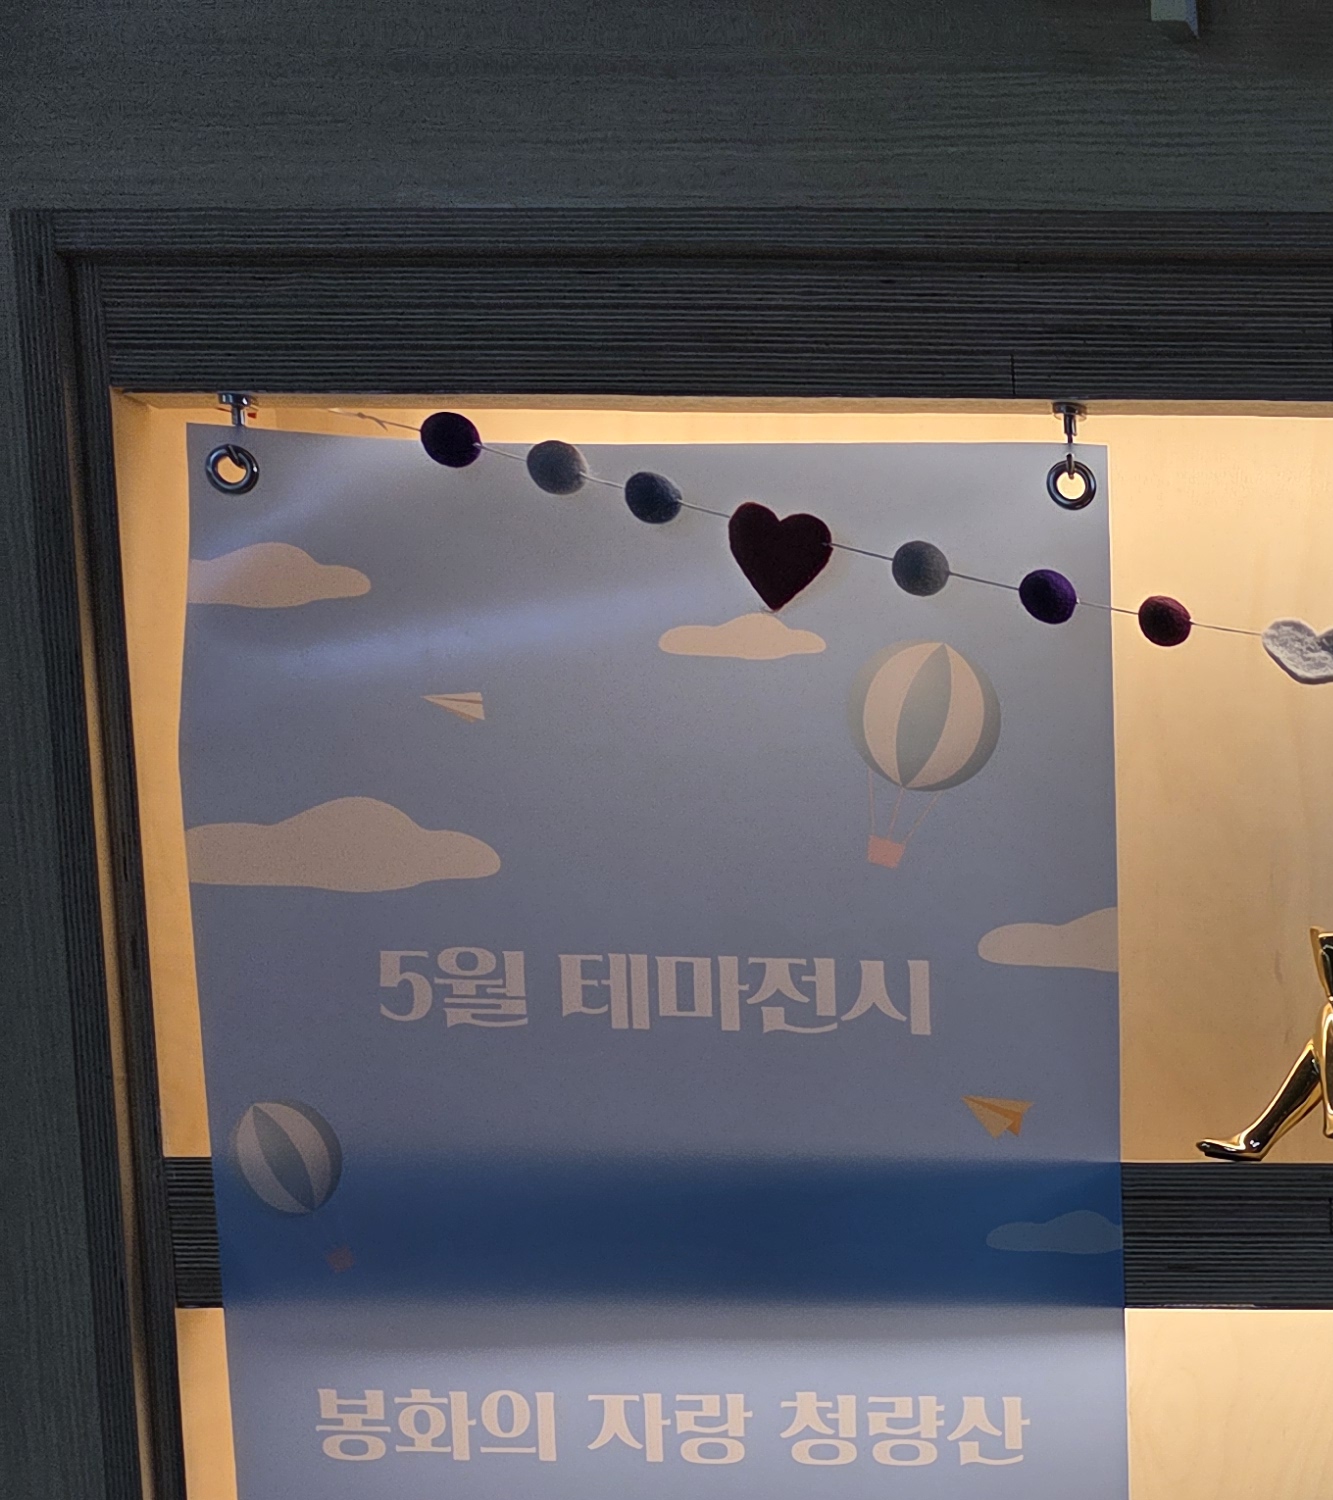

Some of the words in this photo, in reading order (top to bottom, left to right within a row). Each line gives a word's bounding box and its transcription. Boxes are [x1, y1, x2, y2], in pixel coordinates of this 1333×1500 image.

[378, 947, 528, 1028] 5월
[558, 953, 933, 1036] 테마전시
[315, 1387, 558, 1461] 봉화의
[587, 1392, 753, 1466] 자랑
[779, 1393, 1030, 1466] 청량산
